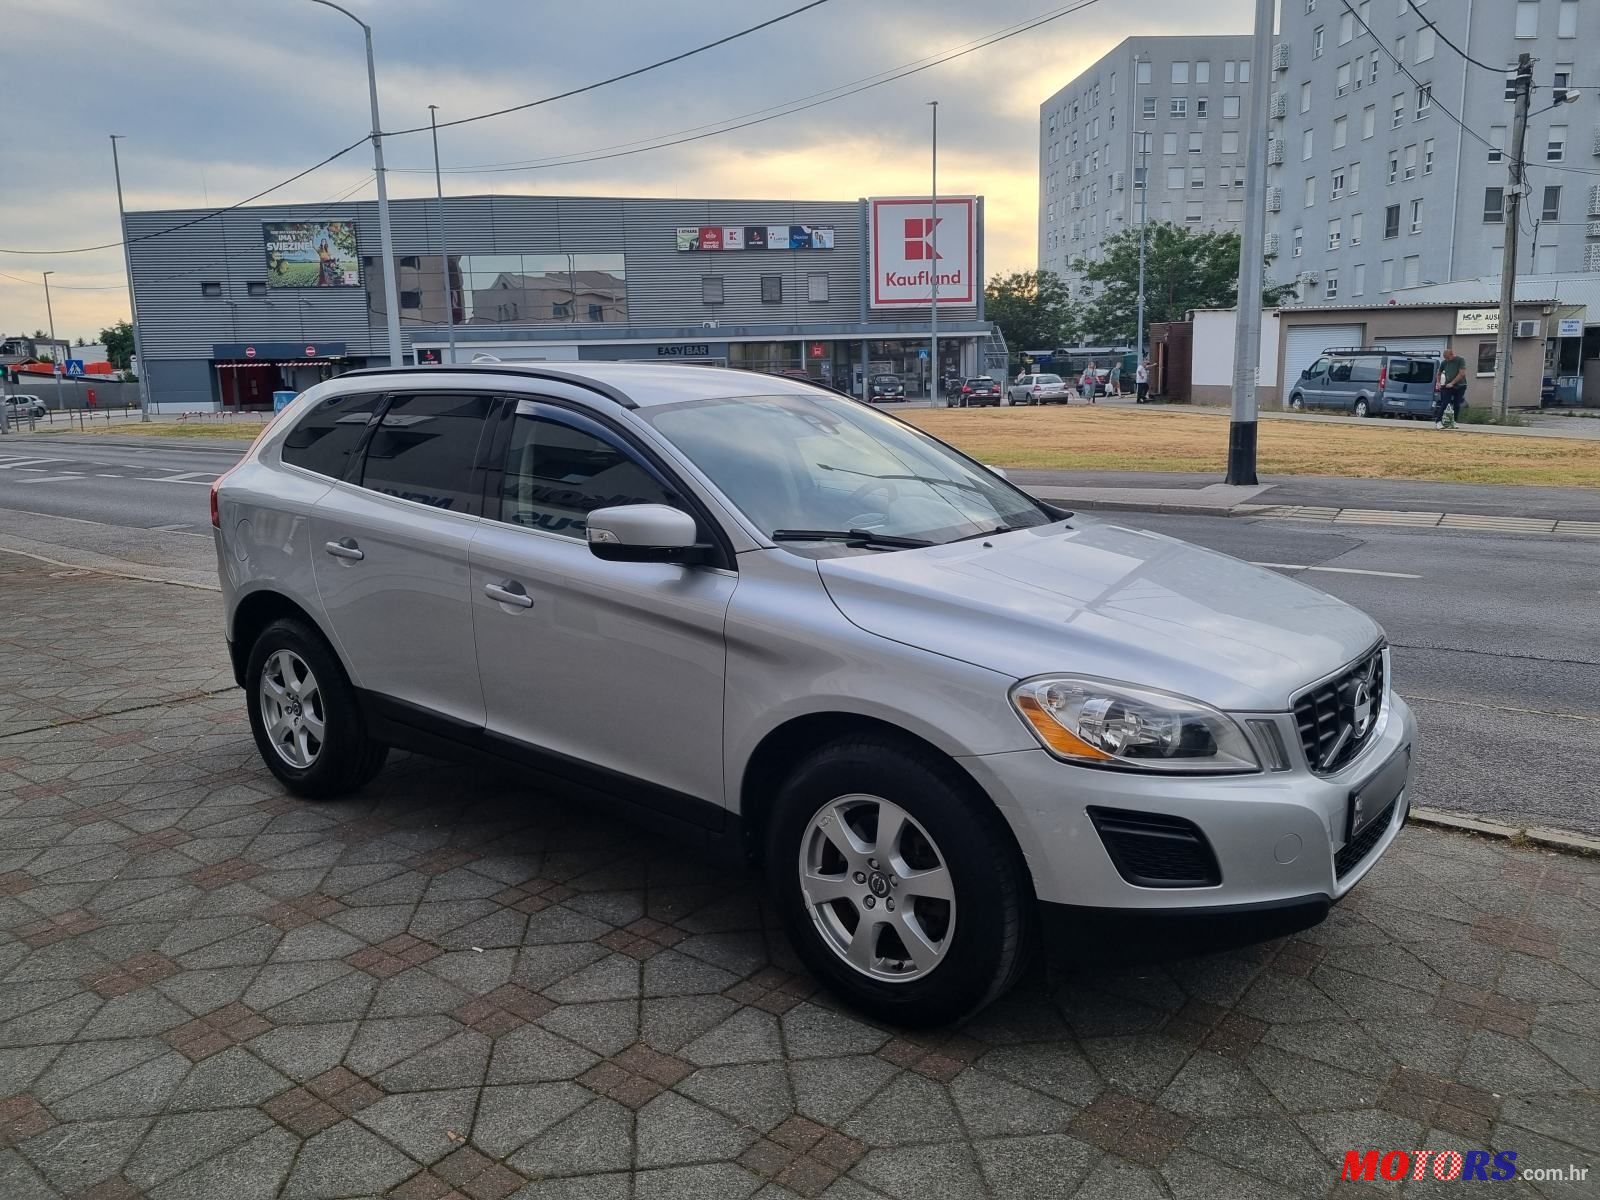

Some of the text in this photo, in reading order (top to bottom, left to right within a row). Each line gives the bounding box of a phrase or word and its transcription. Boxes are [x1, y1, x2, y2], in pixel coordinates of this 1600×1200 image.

[885, 269, 961, 287] Kaufland
[657, 345, 708, 355] EASY BAR
